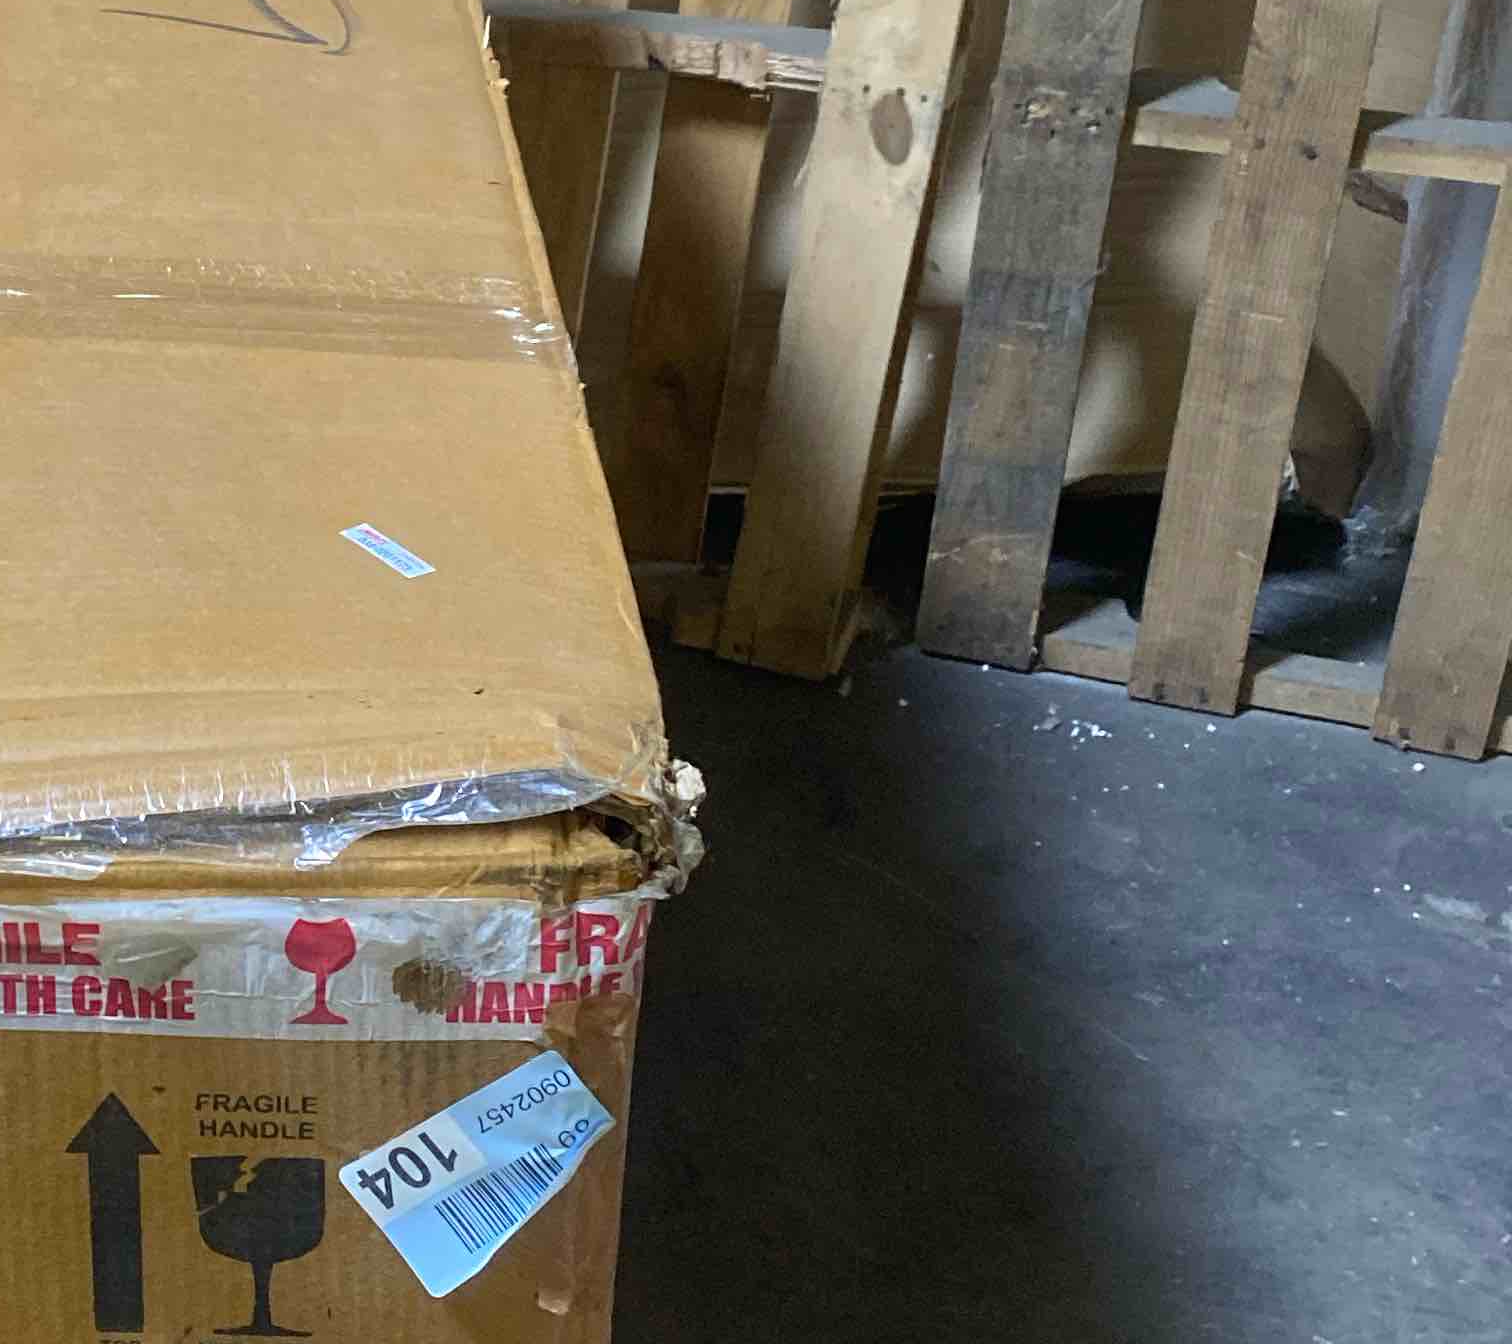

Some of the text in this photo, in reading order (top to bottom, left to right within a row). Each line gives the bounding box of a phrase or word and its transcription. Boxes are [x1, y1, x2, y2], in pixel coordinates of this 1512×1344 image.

[71, 976, 196, 1022] CARE
[194, 1093, 319, 1114] FRAGILE
[478, 1069, 571, 1134] 0902457
[199, 1120, 315, 1140] HANDLE
[557, 1118, 590, 1149] 09
[357, 1132, 459, 1210] 104
